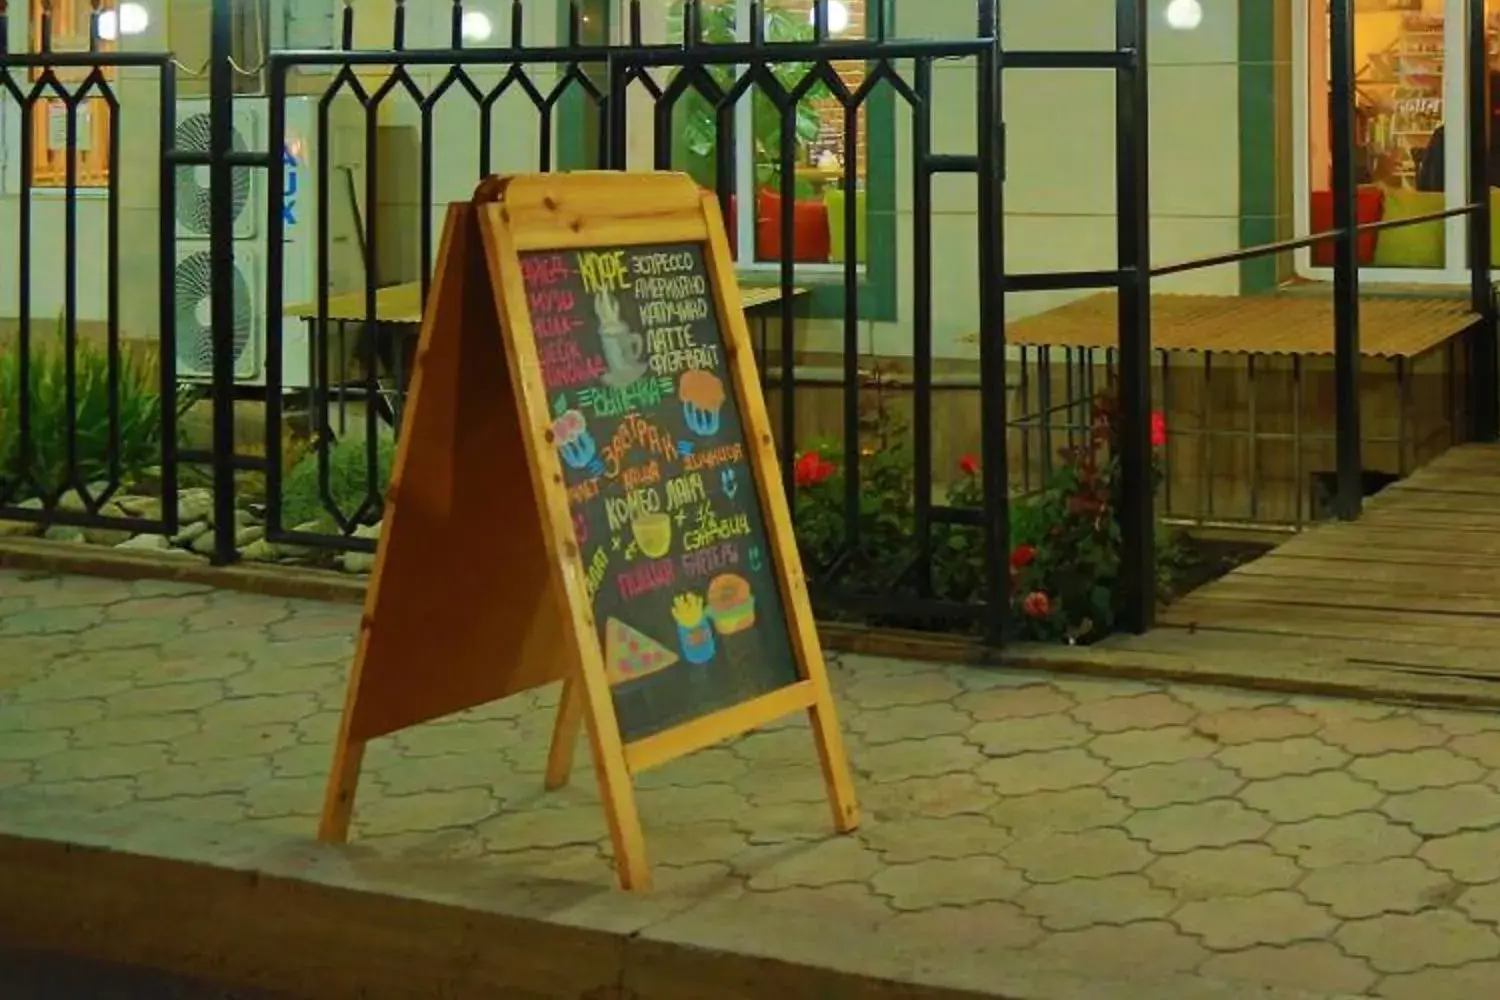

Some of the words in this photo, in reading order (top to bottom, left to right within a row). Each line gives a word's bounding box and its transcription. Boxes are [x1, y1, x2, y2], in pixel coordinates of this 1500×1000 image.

[577, 250, 632, 293] КОФЕ
[646, 324, 697, 355] ЛАТТЕ
[605, 487, 661, 530] КОМБО
